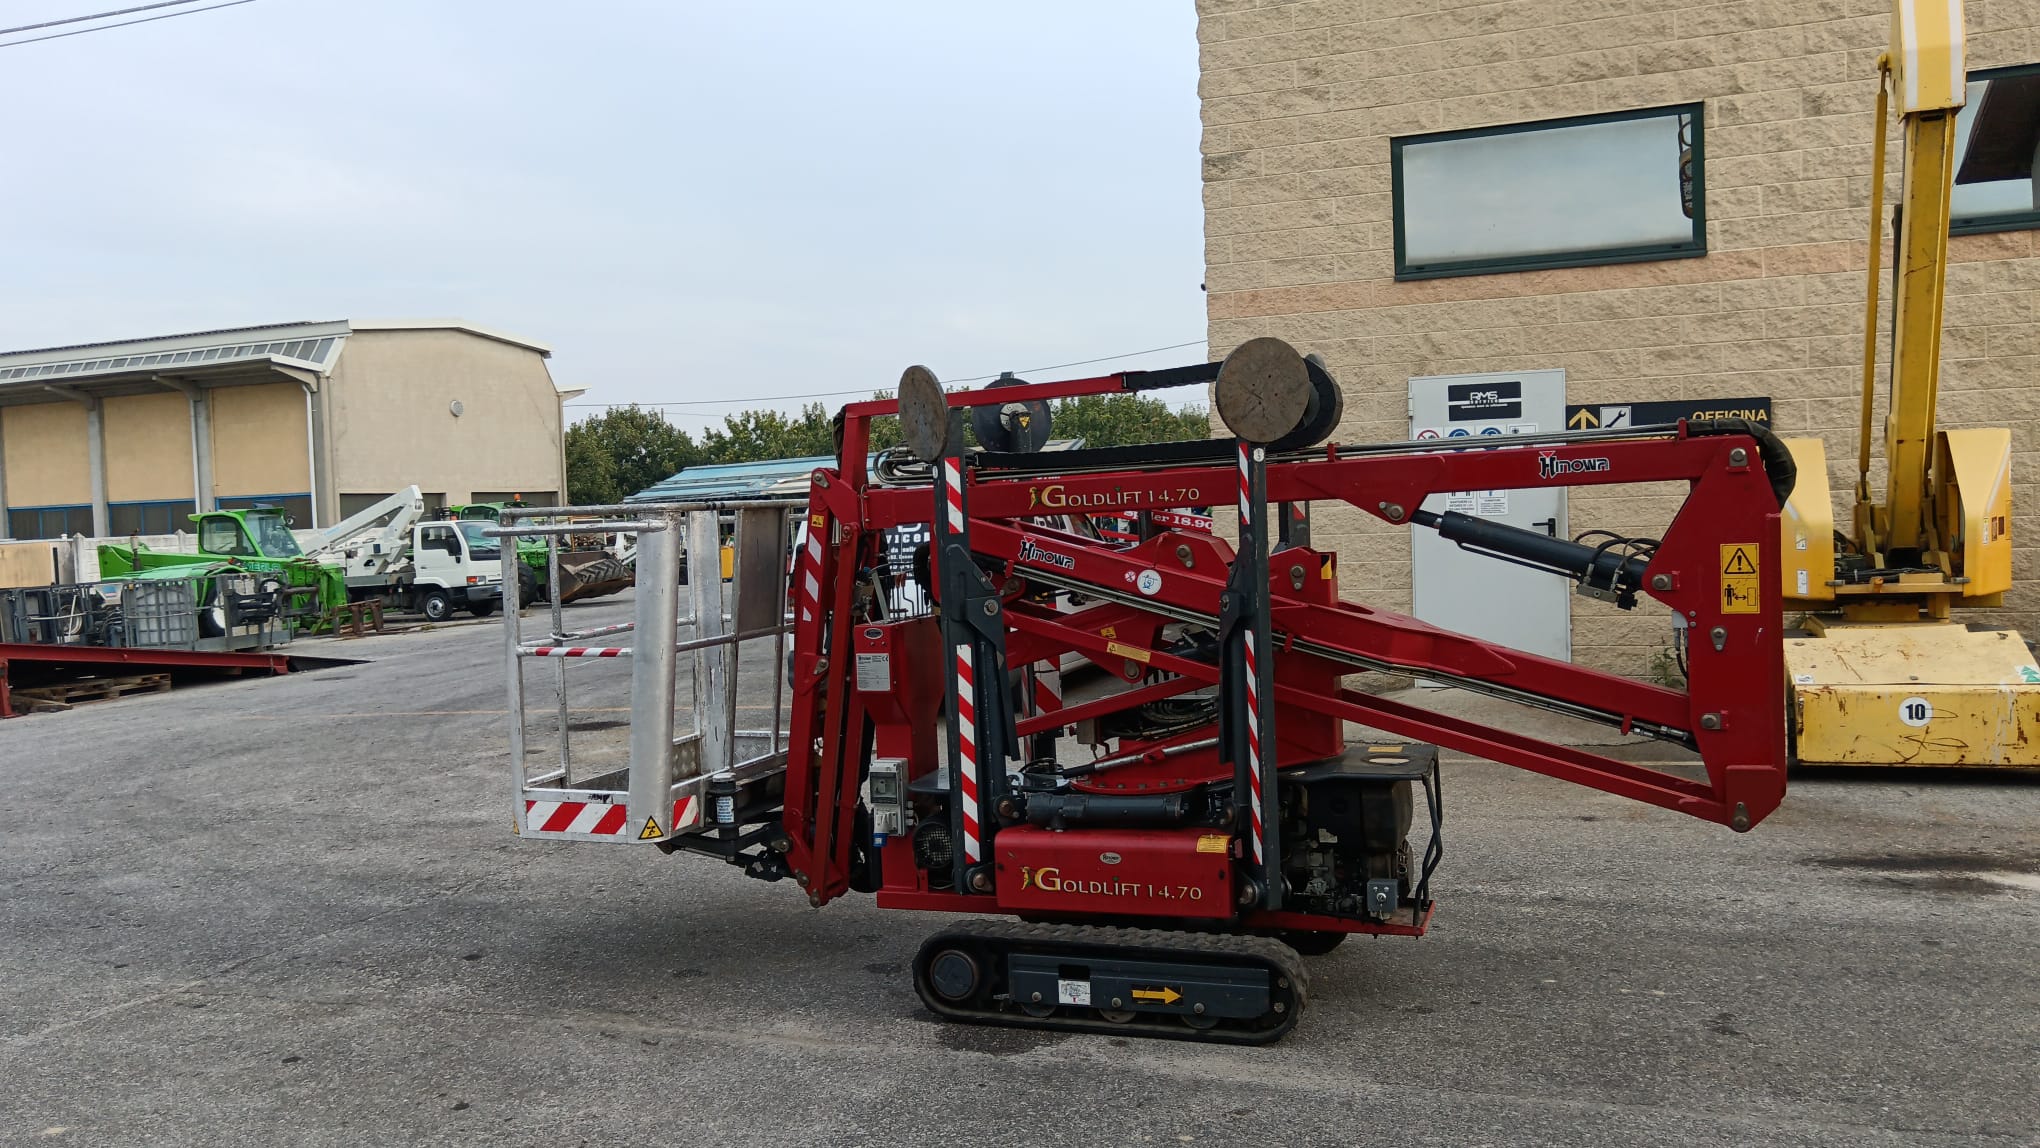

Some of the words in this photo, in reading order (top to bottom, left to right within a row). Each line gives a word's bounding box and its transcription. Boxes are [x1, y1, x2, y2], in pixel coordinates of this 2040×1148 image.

[1470, 390, 1498, 401] RMS
[1692, 408, 1768, 421] OFFICINA
[1148, 487, 1200, 503] 14.70
[1905, 703, 1926, 721] 10
[1147, 885, 1202, 900] 14.70
